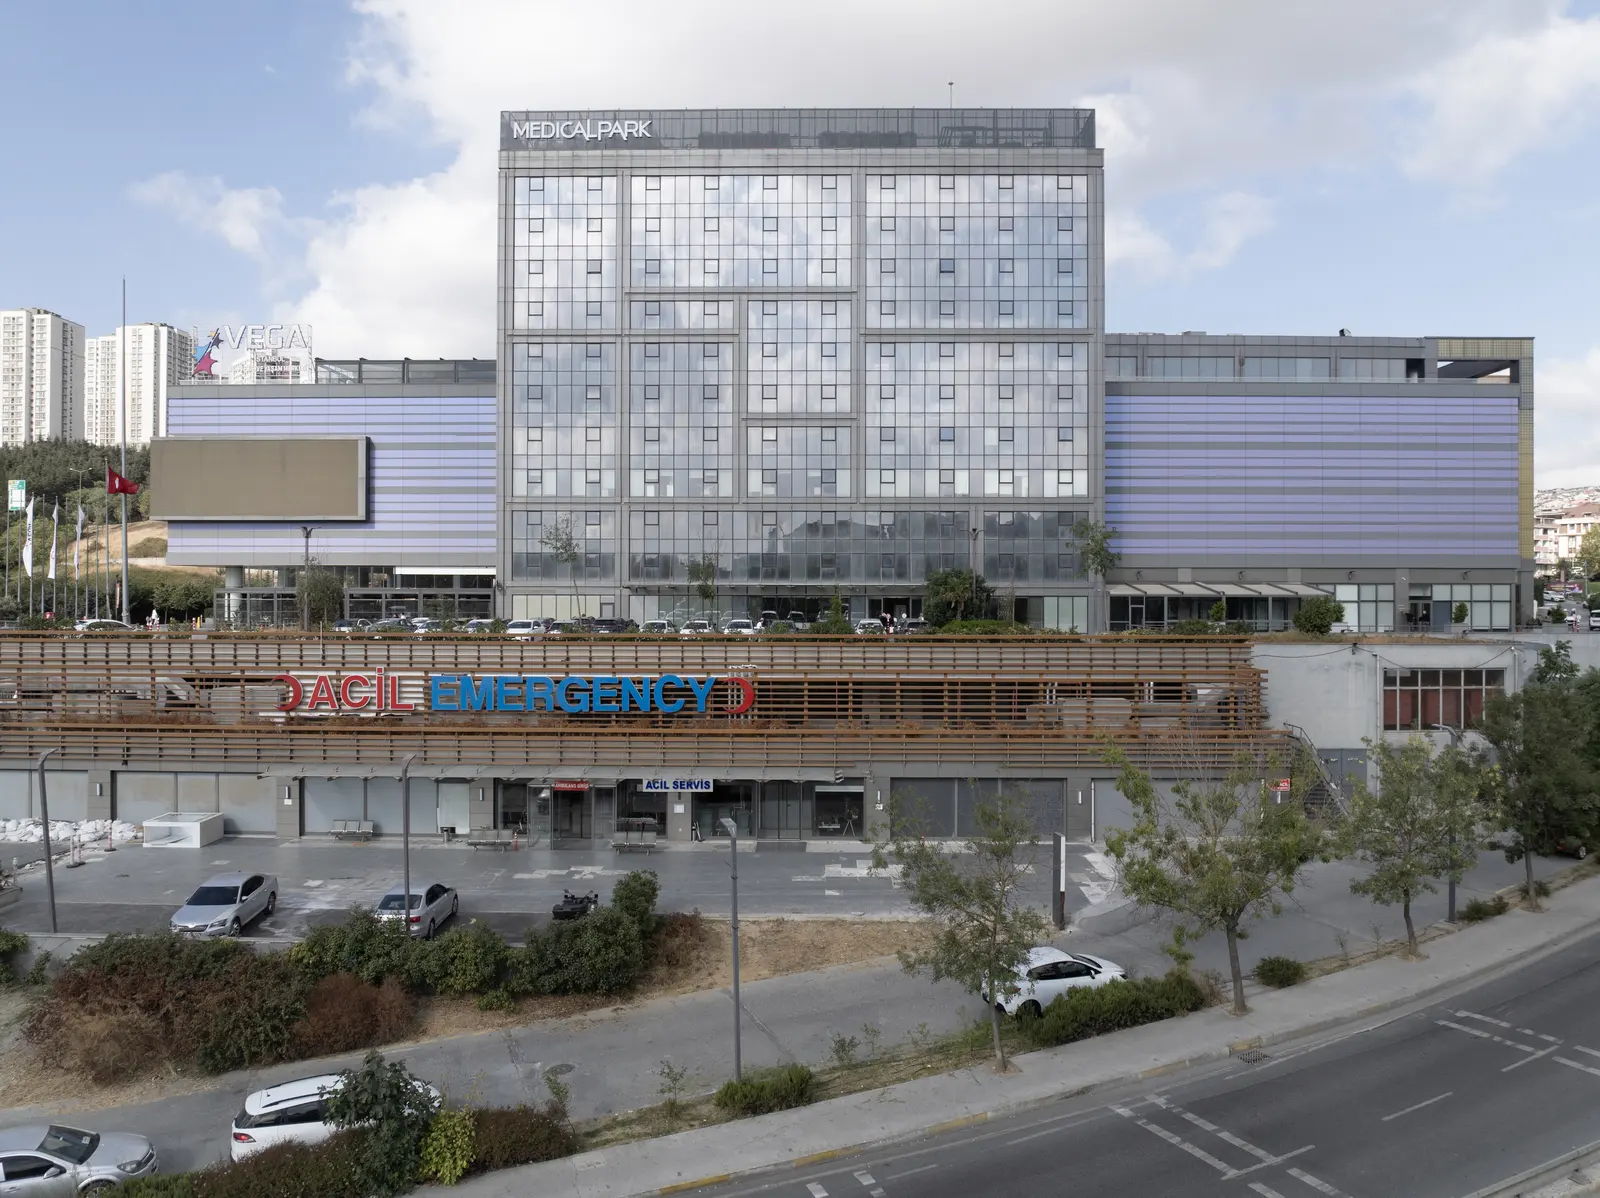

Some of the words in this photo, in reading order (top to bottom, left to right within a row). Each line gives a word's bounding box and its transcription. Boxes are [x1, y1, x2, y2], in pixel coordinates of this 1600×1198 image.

[223, 324, 308, 350] VEGA
[307, 667, 415, 711] ACİL
[431, 675, 716, 713] EMERGENCY
[645, 778, 669, 790] ACİL
[672, 778, 711, 790] SERVİS
